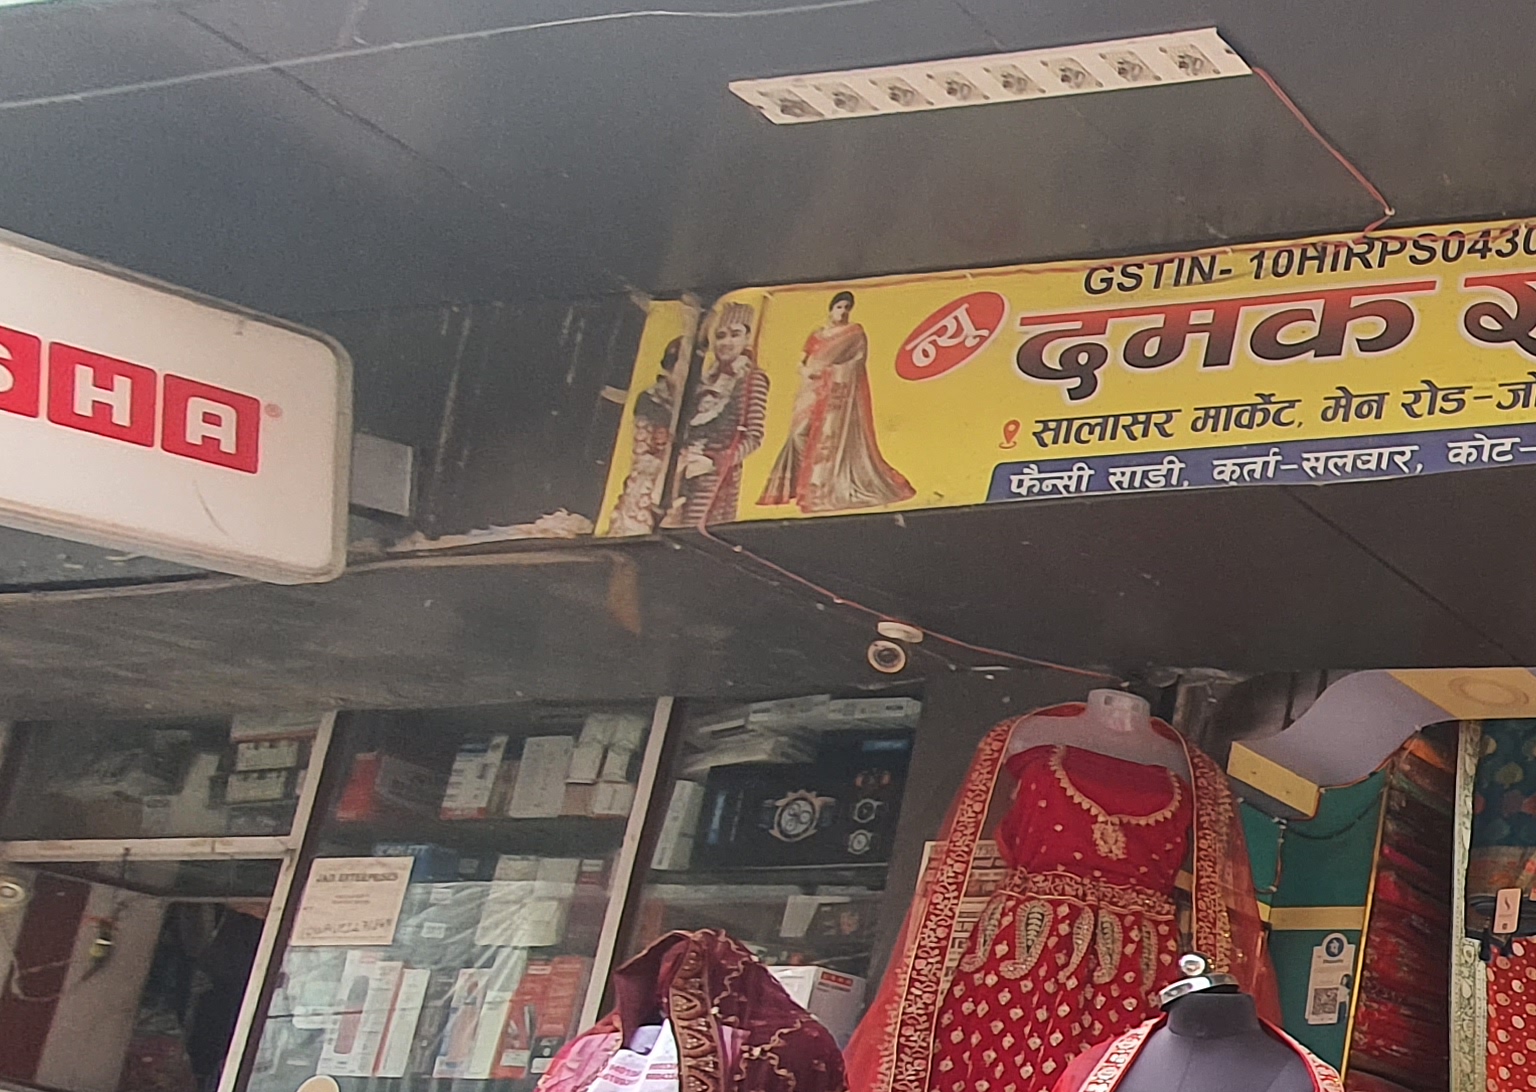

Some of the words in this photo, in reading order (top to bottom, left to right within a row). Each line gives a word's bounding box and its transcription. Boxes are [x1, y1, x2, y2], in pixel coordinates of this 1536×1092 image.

[905, 303, 992, 372] न्यू
[1015, 280, 1438, 400] दमक
[0, 340, 238, 456] HA
[1031, 407, 1181, 448] सालासर
[1190, 392, 1304, 433] मार्केट,
[1320, 386, 1390, 423] मेन
[1009, 460, 1095, 497] फैन्सी
